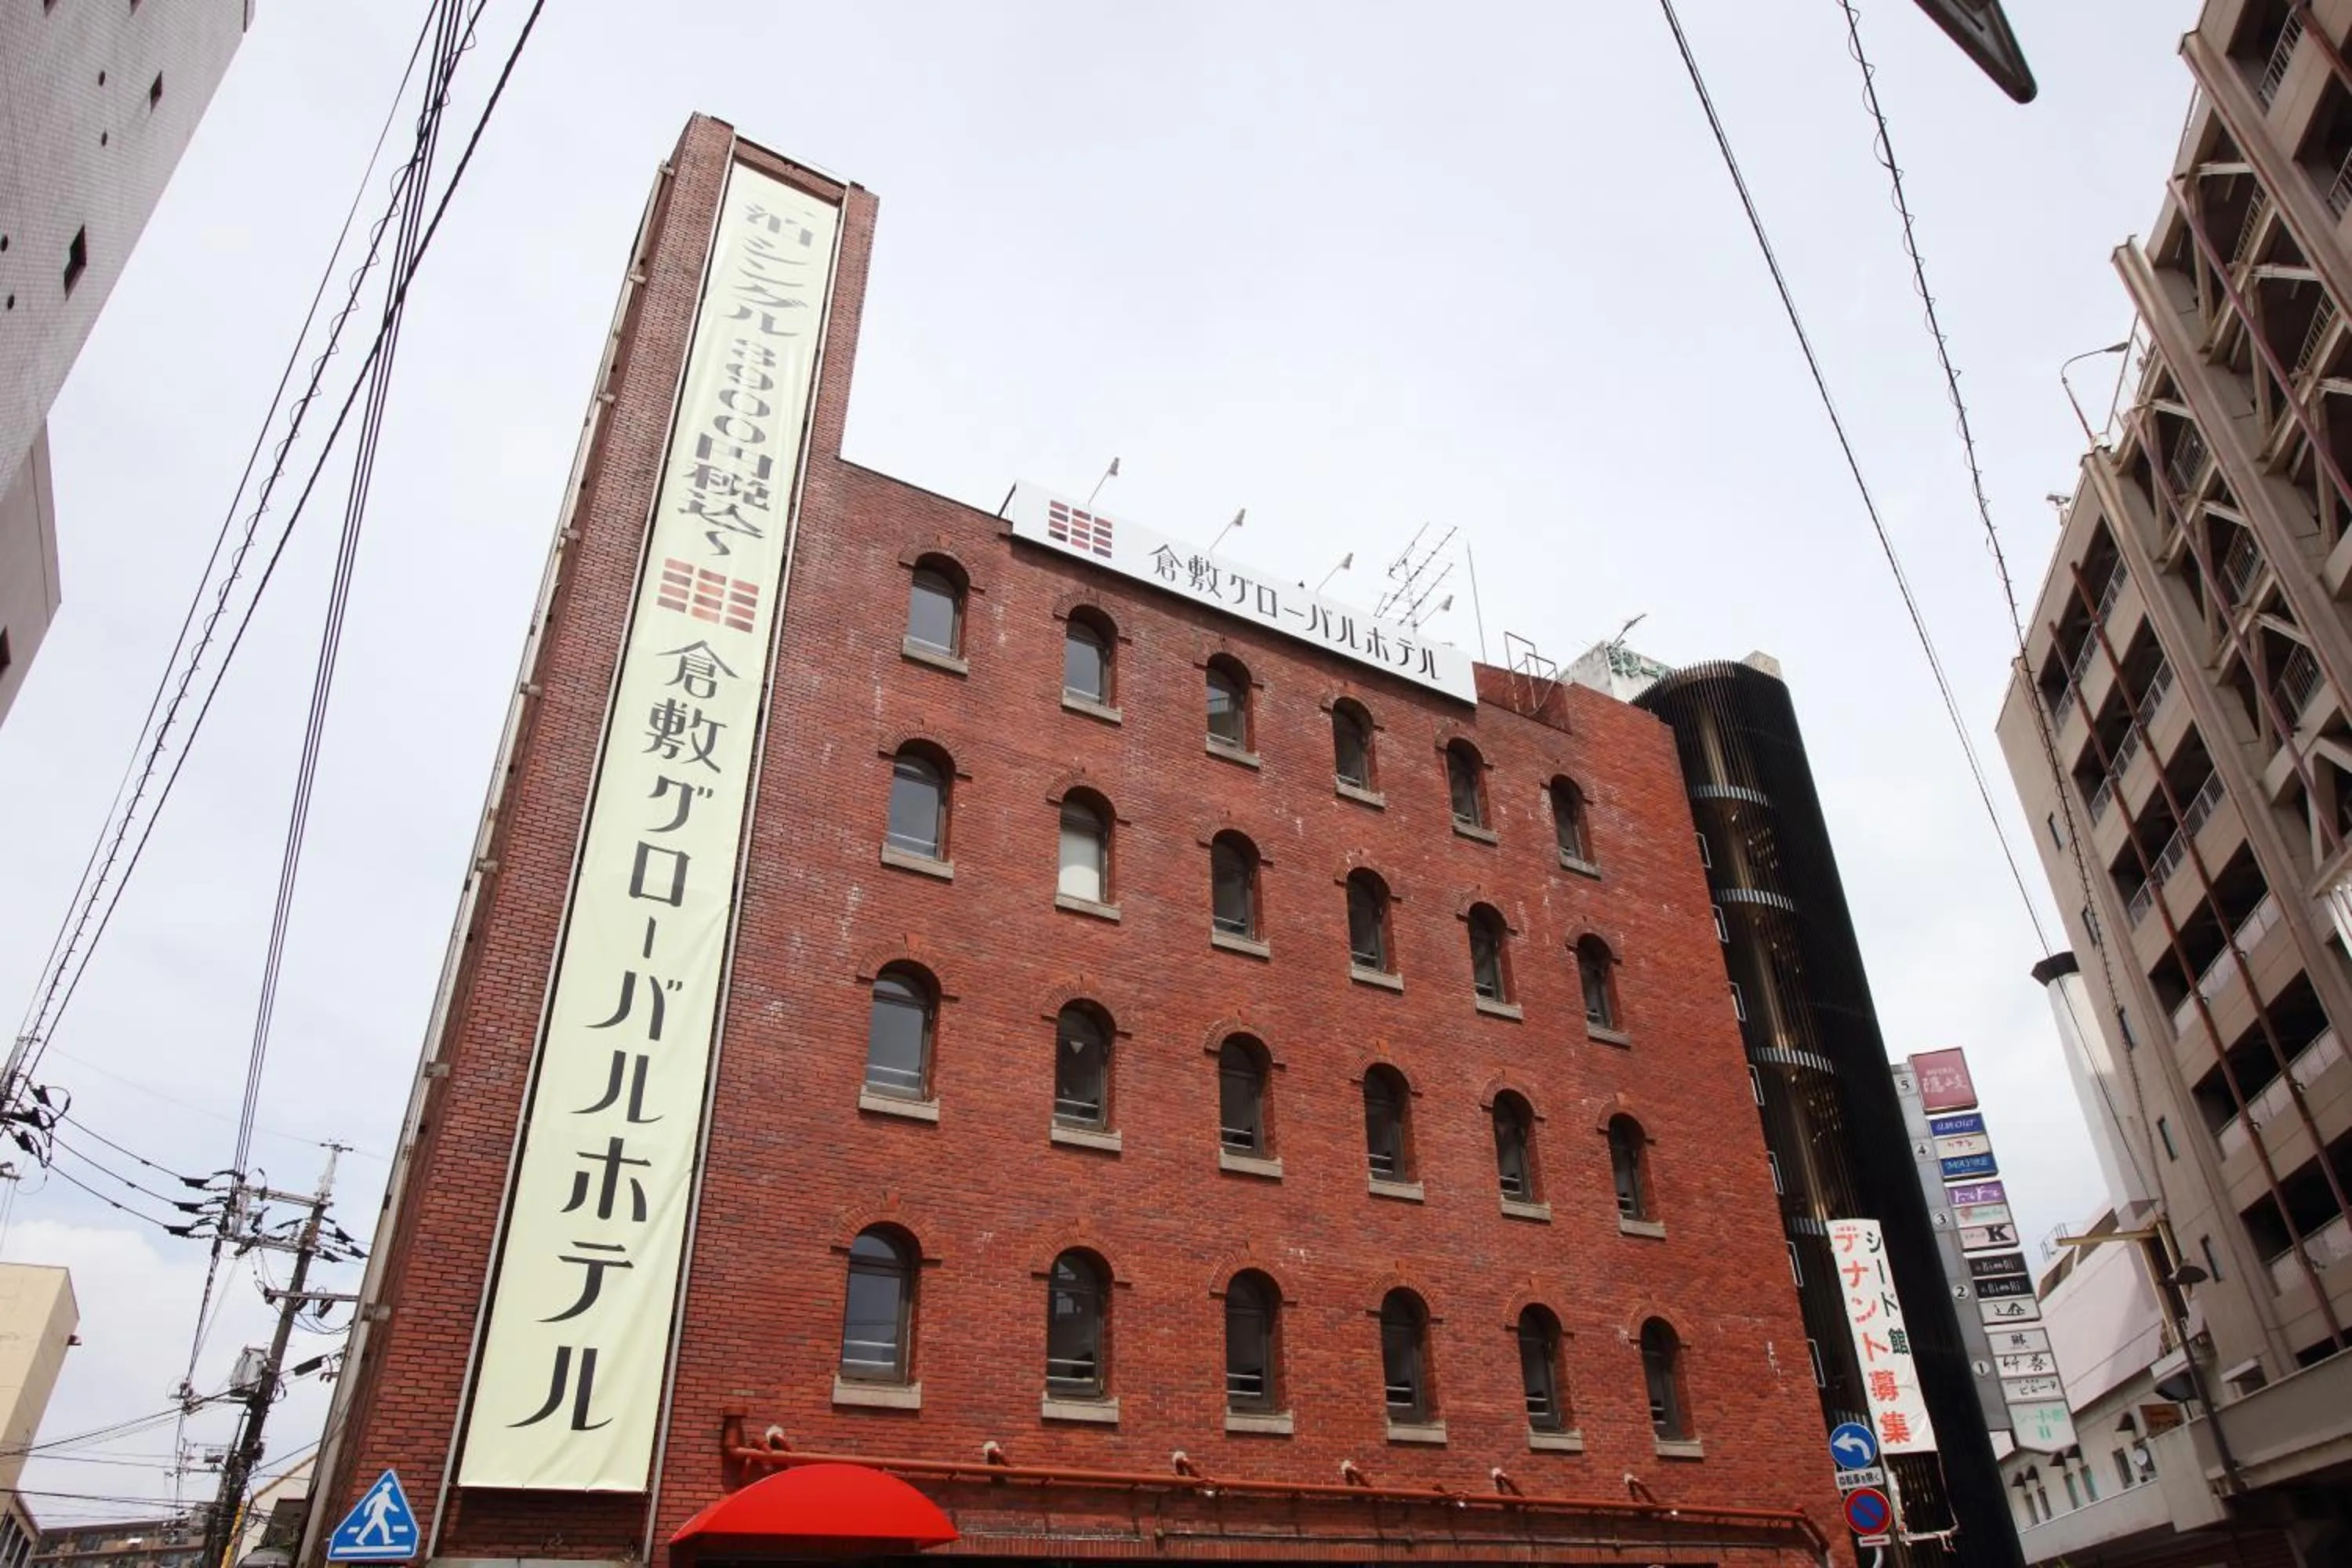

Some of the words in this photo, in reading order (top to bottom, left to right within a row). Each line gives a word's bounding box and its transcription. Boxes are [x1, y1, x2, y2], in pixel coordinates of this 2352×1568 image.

[1148, 543, 1442, 680] 倉敷グローバルホテル
[506, 639, 739, 1431] 倉敷グローバルホテル
[1956, 1286, 1965, 1298] 2
[1985, 1224, 2012, 1243] K
[1833, 1225, 1911, 1444] テナント募集
